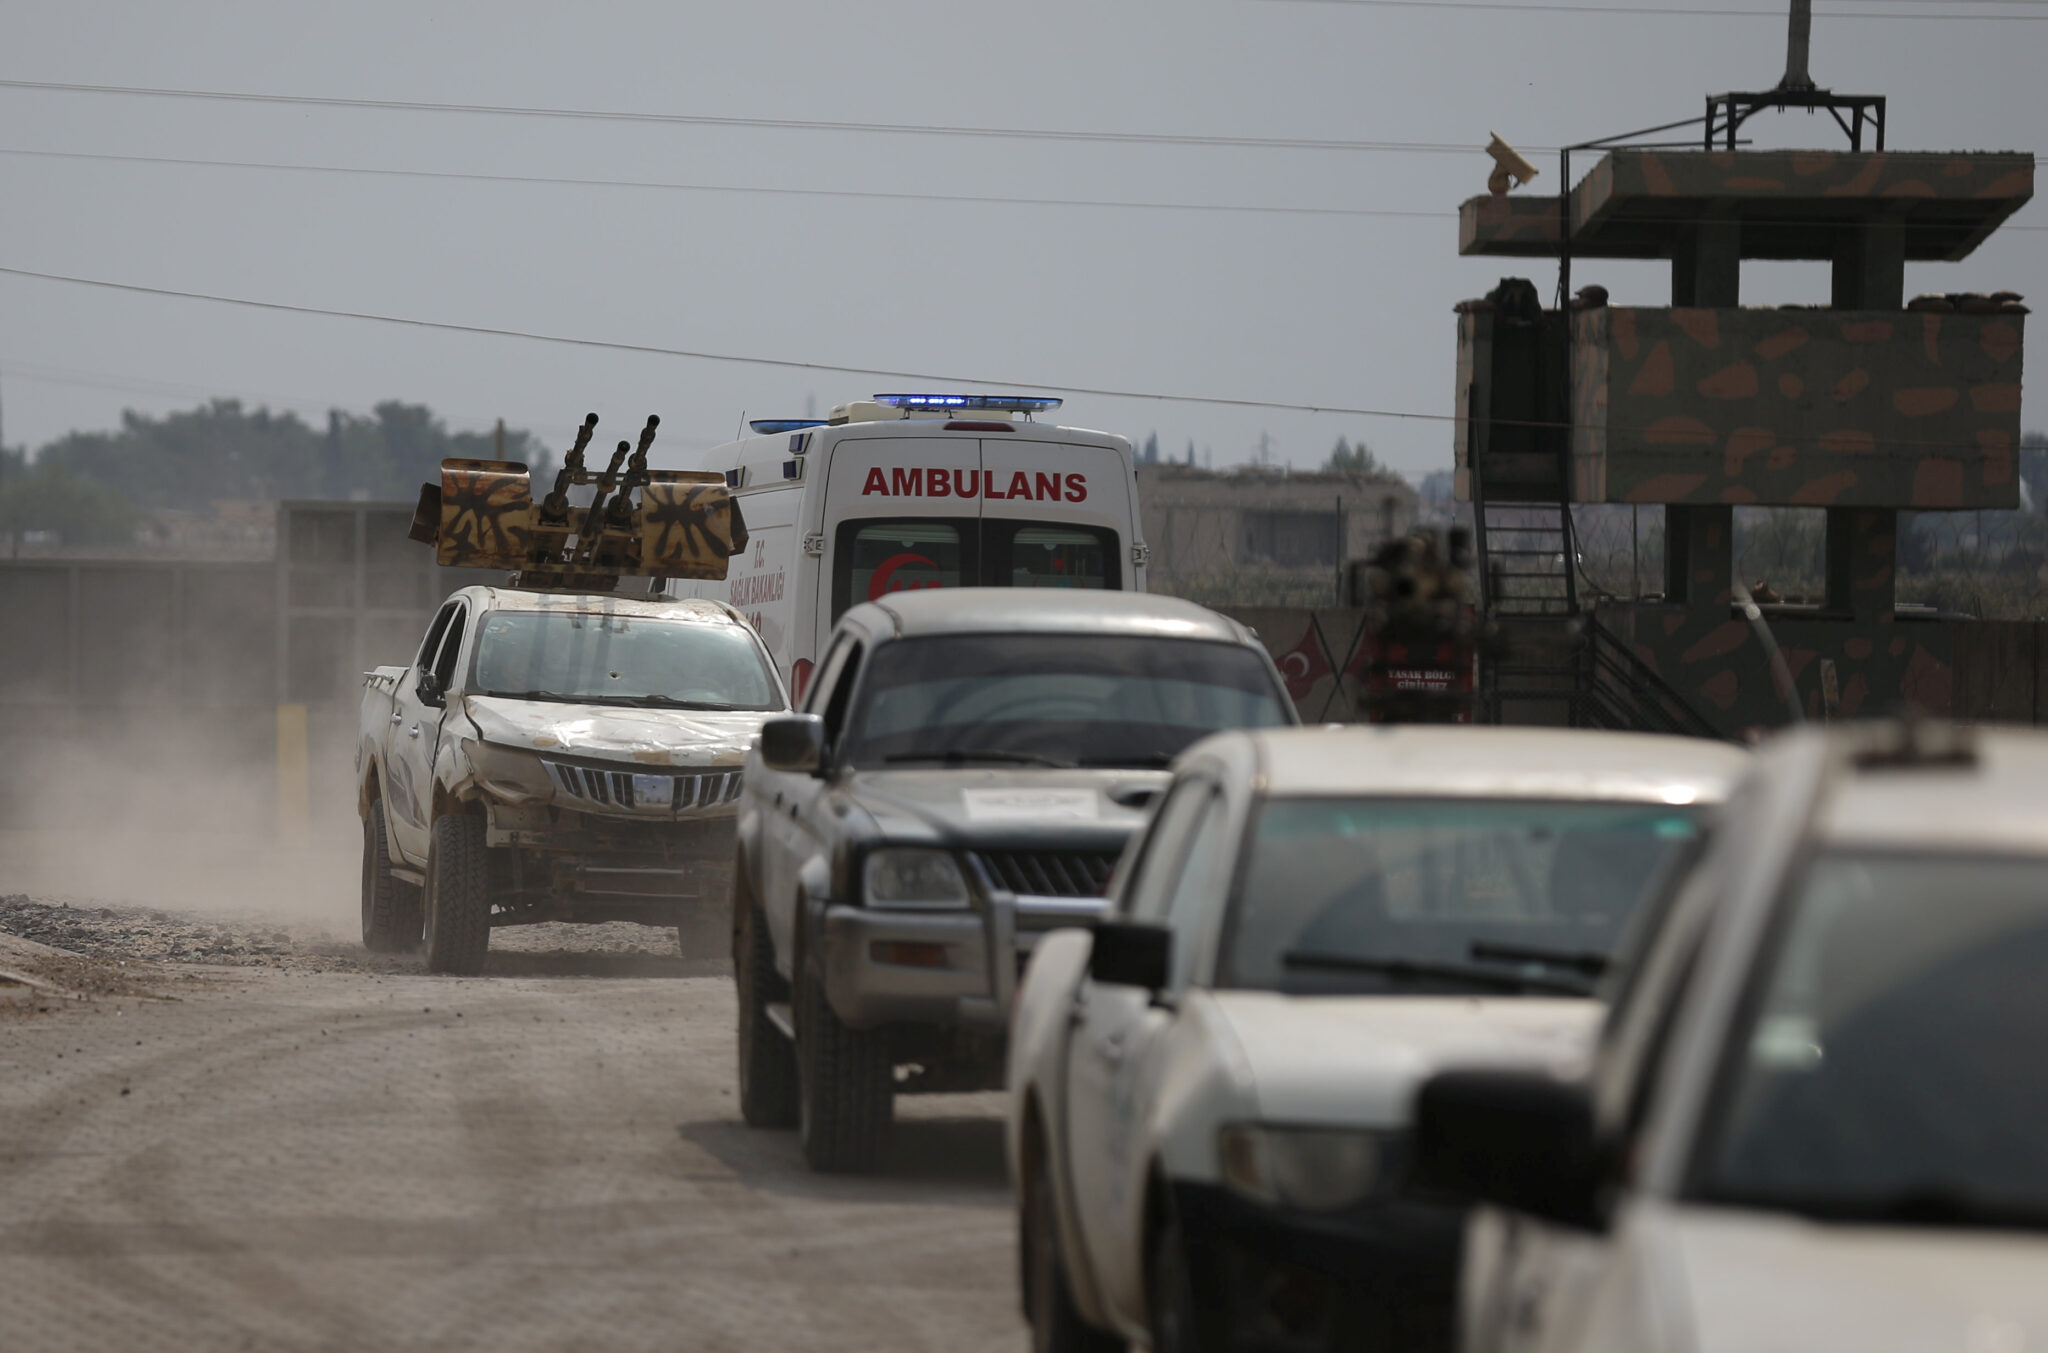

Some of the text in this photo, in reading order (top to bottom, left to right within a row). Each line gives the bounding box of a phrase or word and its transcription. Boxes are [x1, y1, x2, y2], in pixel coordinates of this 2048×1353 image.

[861, 466, 1087, 503] AMBULANS
[730, 566, 785, 607] SAĞLIK BAKANLIĞI
